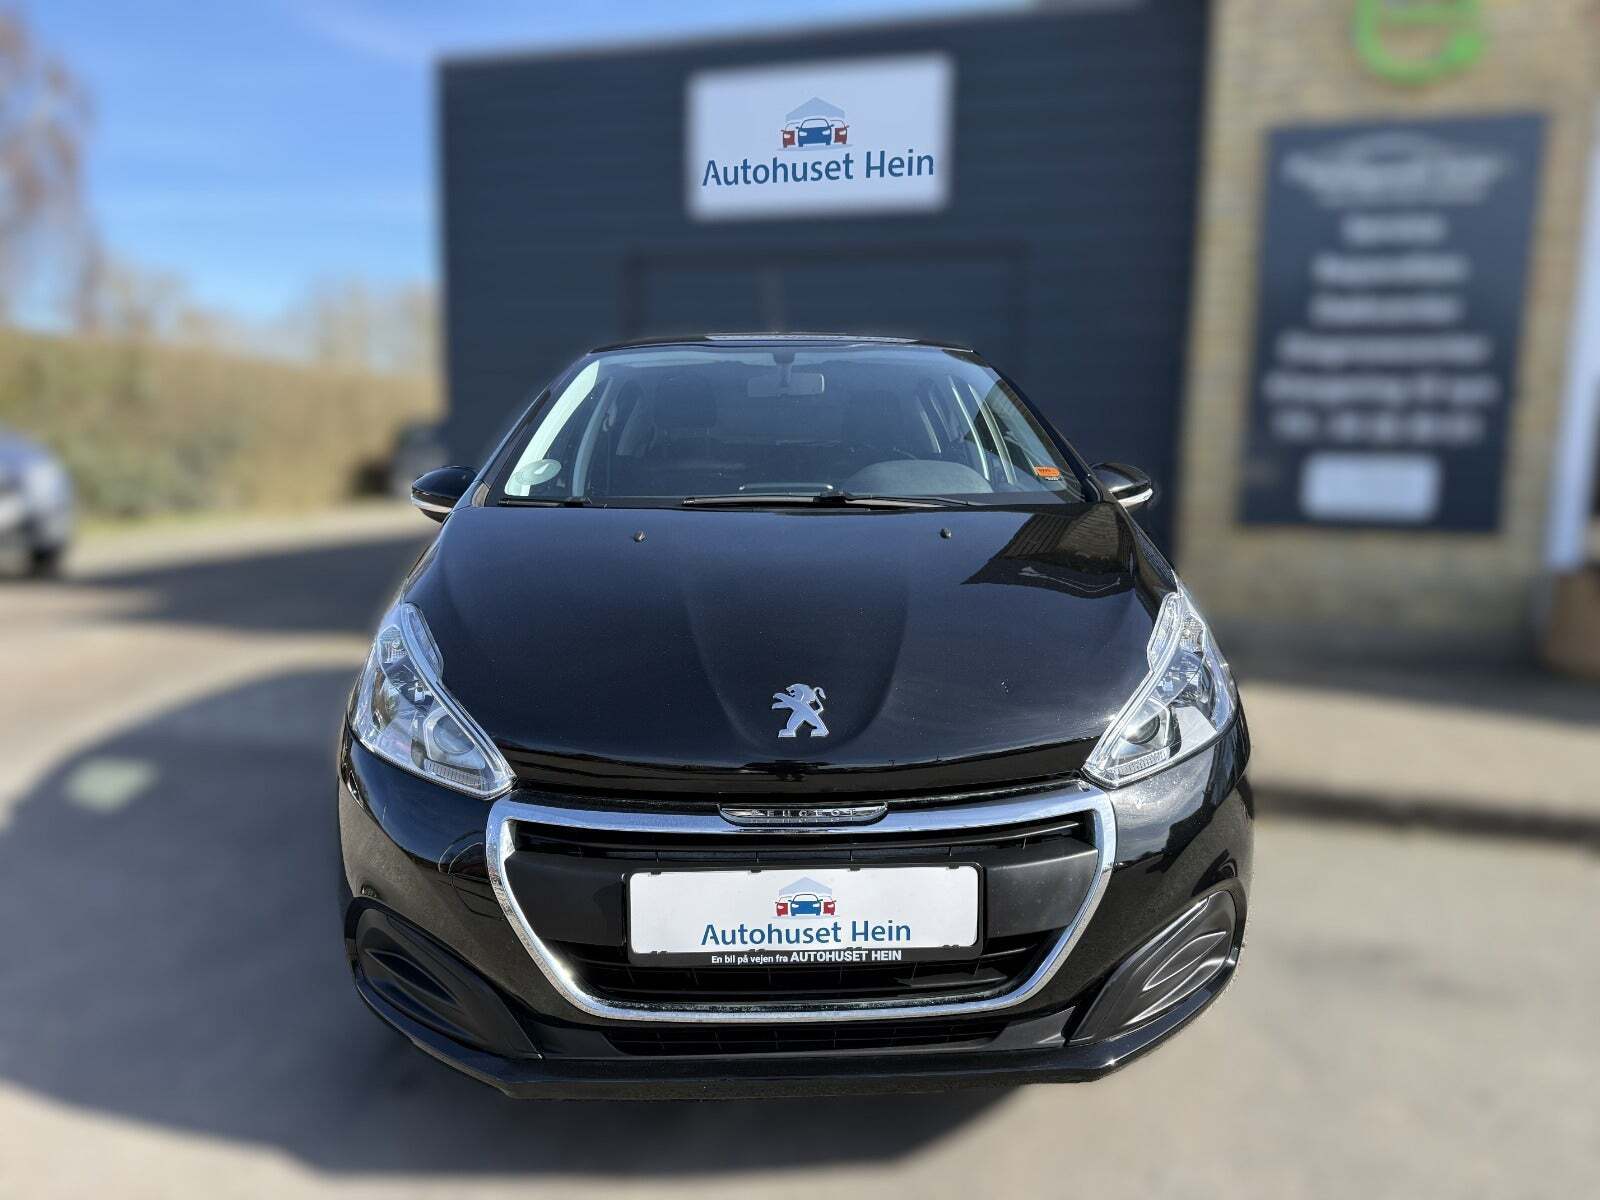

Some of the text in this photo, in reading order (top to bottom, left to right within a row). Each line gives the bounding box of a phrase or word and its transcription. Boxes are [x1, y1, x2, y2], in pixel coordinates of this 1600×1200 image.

[702, 148, 934, 186] Autohuset Hein
[701, 920, 911, 945] Autohuset Hein
[711, 949, 902, 966] En bil på vejen fra AUTOHUSET HEIN
